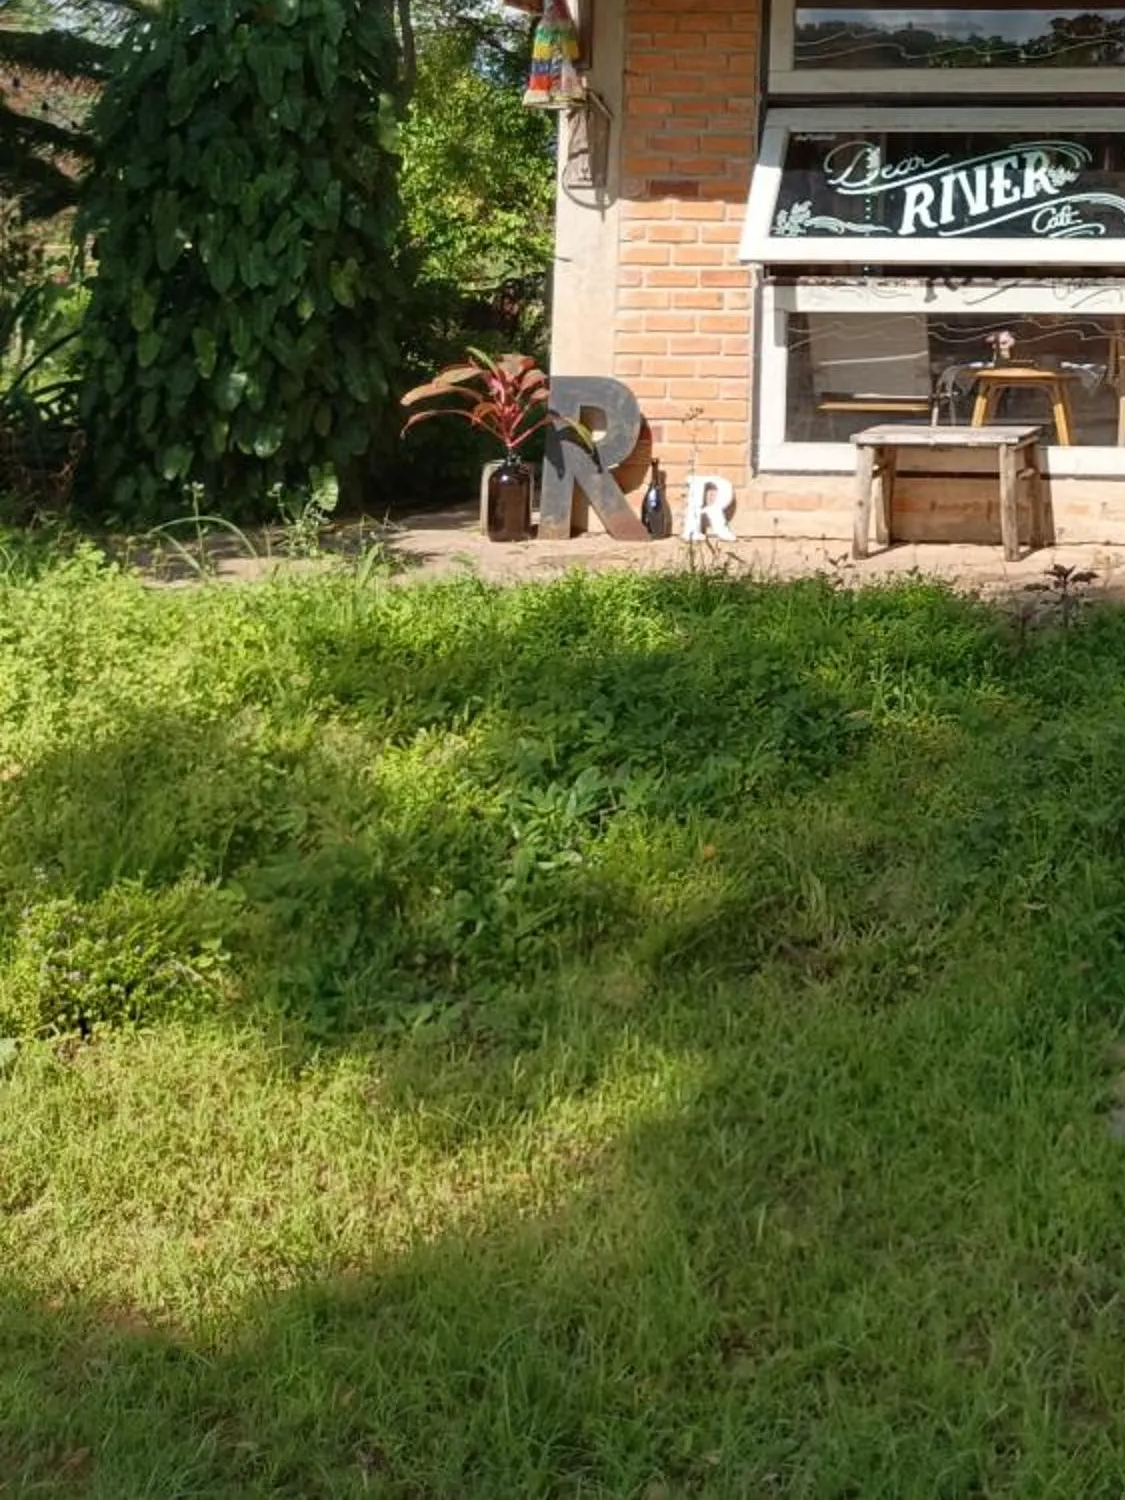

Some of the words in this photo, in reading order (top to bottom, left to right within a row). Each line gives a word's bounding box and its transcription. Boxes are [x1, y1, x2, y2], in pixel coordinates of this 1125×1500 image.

[898, 151, 1060, 235] RIVER
[538, 375, 651, 541] R
[681, 475, 737, 541] R
